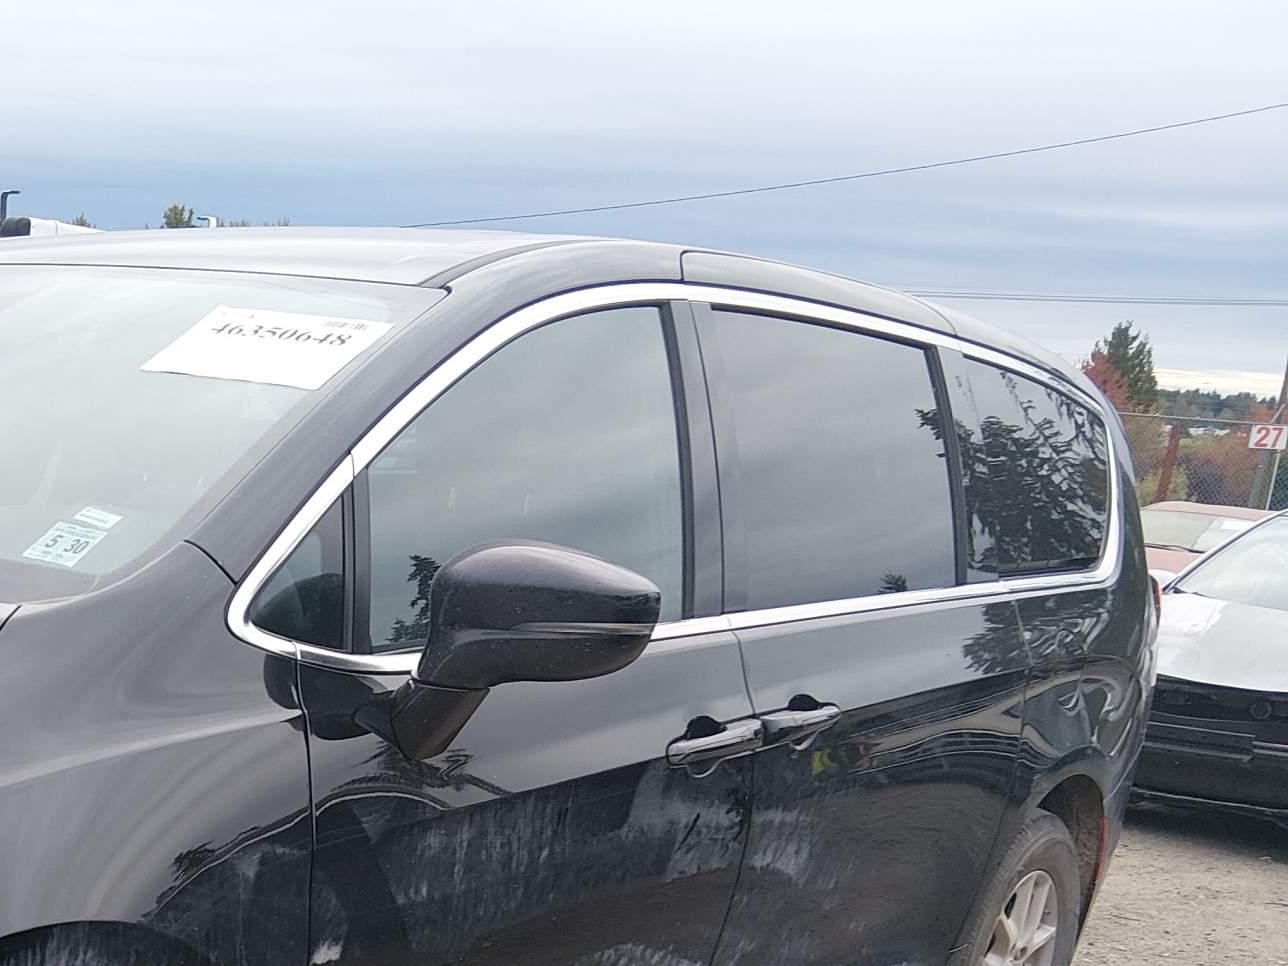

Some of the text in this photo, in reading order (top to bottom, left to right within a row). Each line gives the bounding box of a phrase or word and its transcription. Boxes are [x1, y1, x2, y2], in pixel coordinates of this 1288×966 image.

[210, 322, 352, 346] 46350648
[1254, 427, 1284, 448] 27
[45, 534, 65, 549] 5
[64, 538, 90, 555] 30
